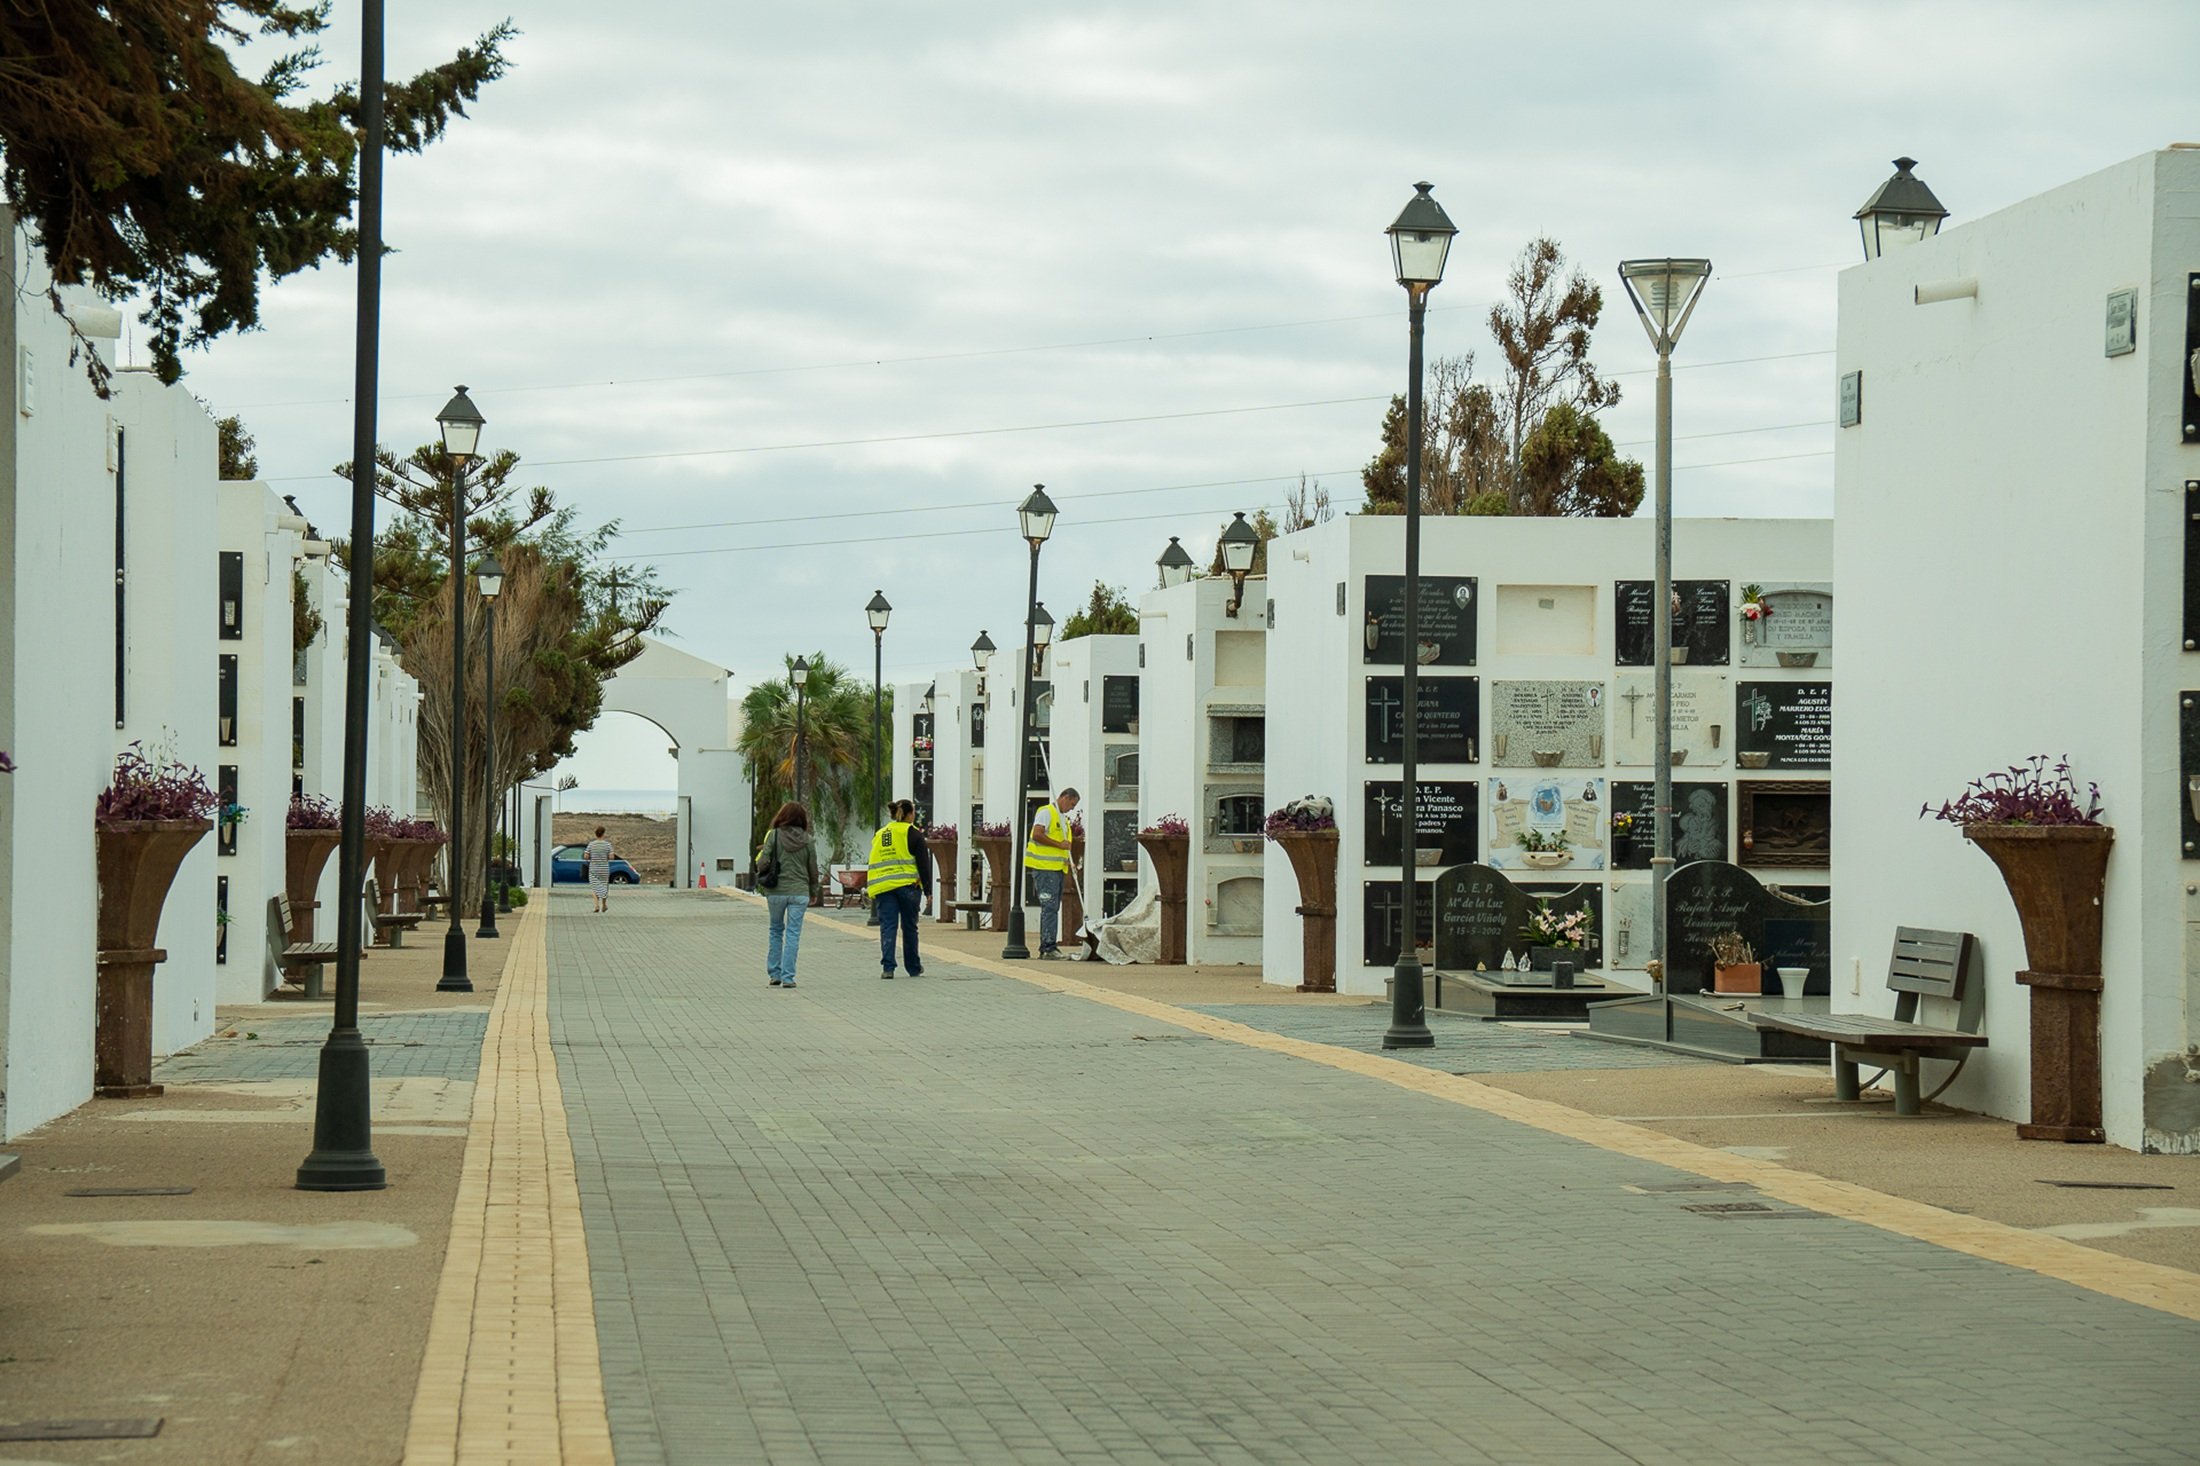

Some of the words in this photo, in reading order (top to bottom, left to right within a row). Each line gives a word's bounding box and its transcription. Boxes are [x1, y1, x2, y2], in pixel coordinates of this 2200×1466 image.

[1424, 786, 1433, 794] E.
[1434, 786, 1443, 794] P.
[1423, 794, 1456, 803] Vicente
[1427, 803, 1464, 812] Panasco
[1456, 882, 1467, 894] D.
[1485, 882, 1494, 894] P.
[1461, 896, 1474, 908] de
[1475, 897, 1486, 908] la
[1486, 897, 1504, 908] Luz
[1675, 900, 1714, 917] Rafael
[1476, 911, 1508, 926] Viñoly
